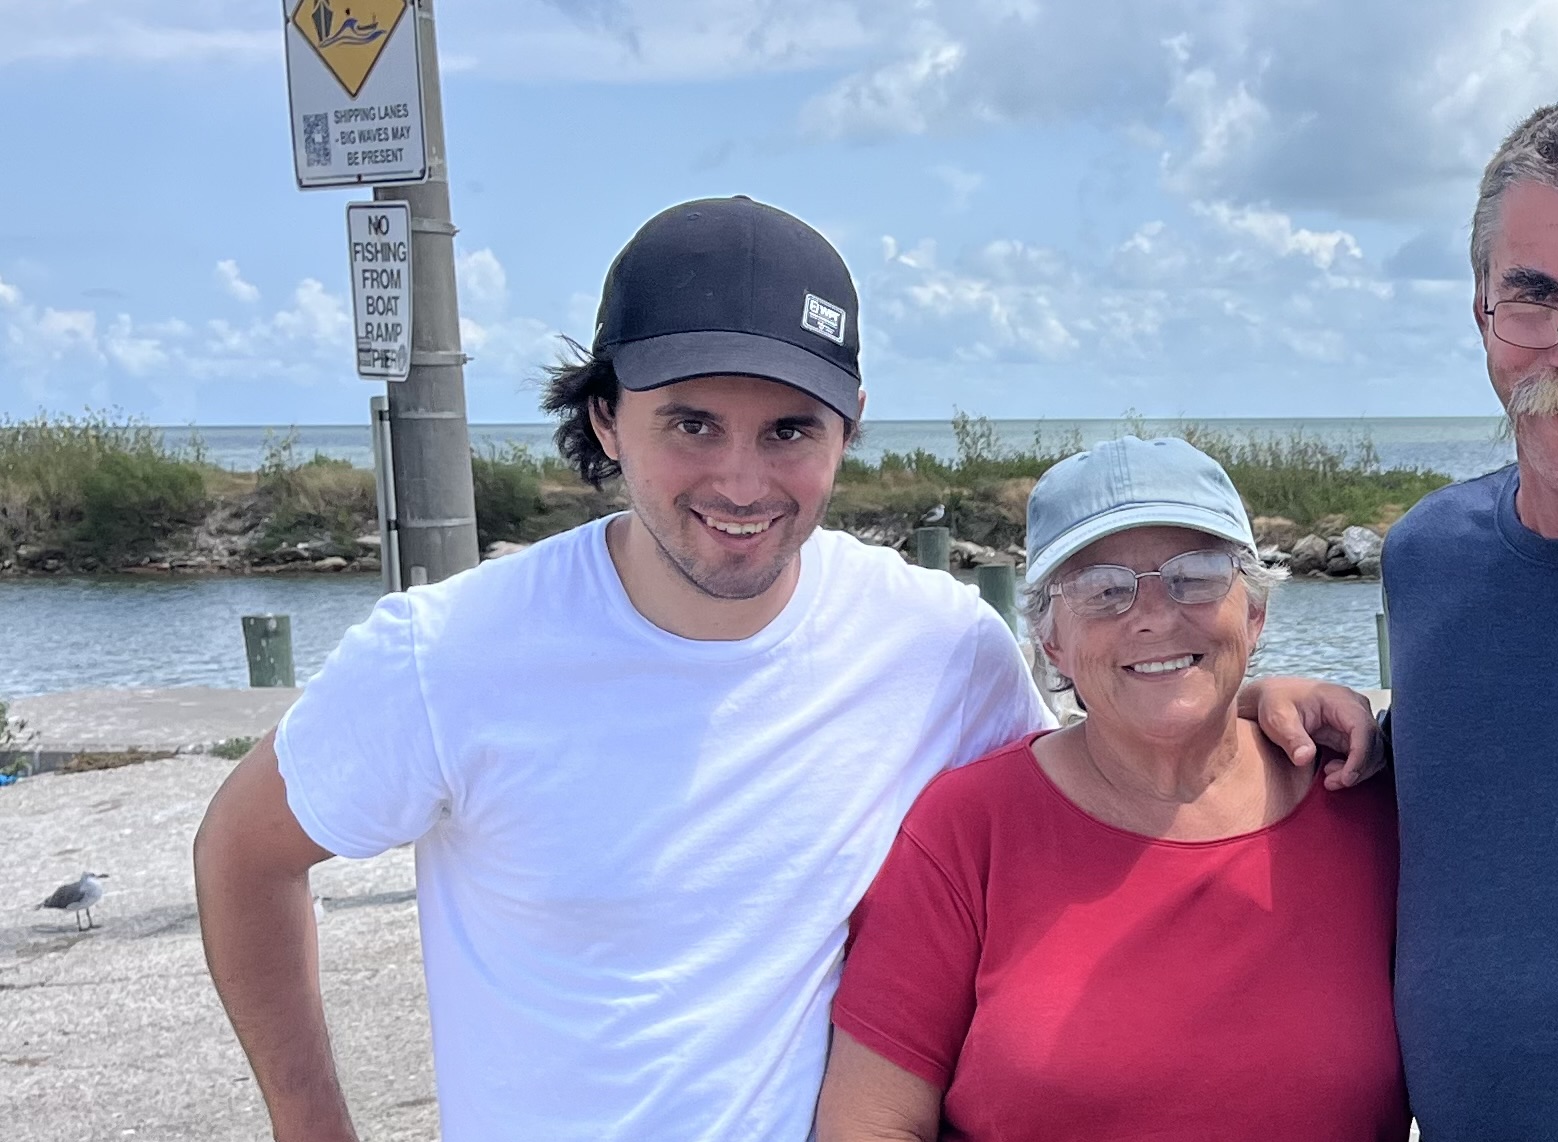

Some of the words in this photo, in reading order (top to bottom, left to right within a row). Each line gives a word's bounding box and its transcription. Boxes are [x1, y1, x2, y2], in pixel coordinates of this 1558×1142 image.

[333, 106, 376, 124] SHIPPING
[378, 103, 409, 120] LANES
[358, 127, 390, 144] WAVES
[391, 126, 411, 141] MAY
[347, 151, 360, 166] BE
[361, 148, 404, 165] PRESENT
[368, 215, 390, 236] NO
[353, 241, 407, 263] FISHING
[361, 268, 401, 290] FROM
[366, 295, 400, 316] BOAT
[365, 322, 403, 343] RAMP
